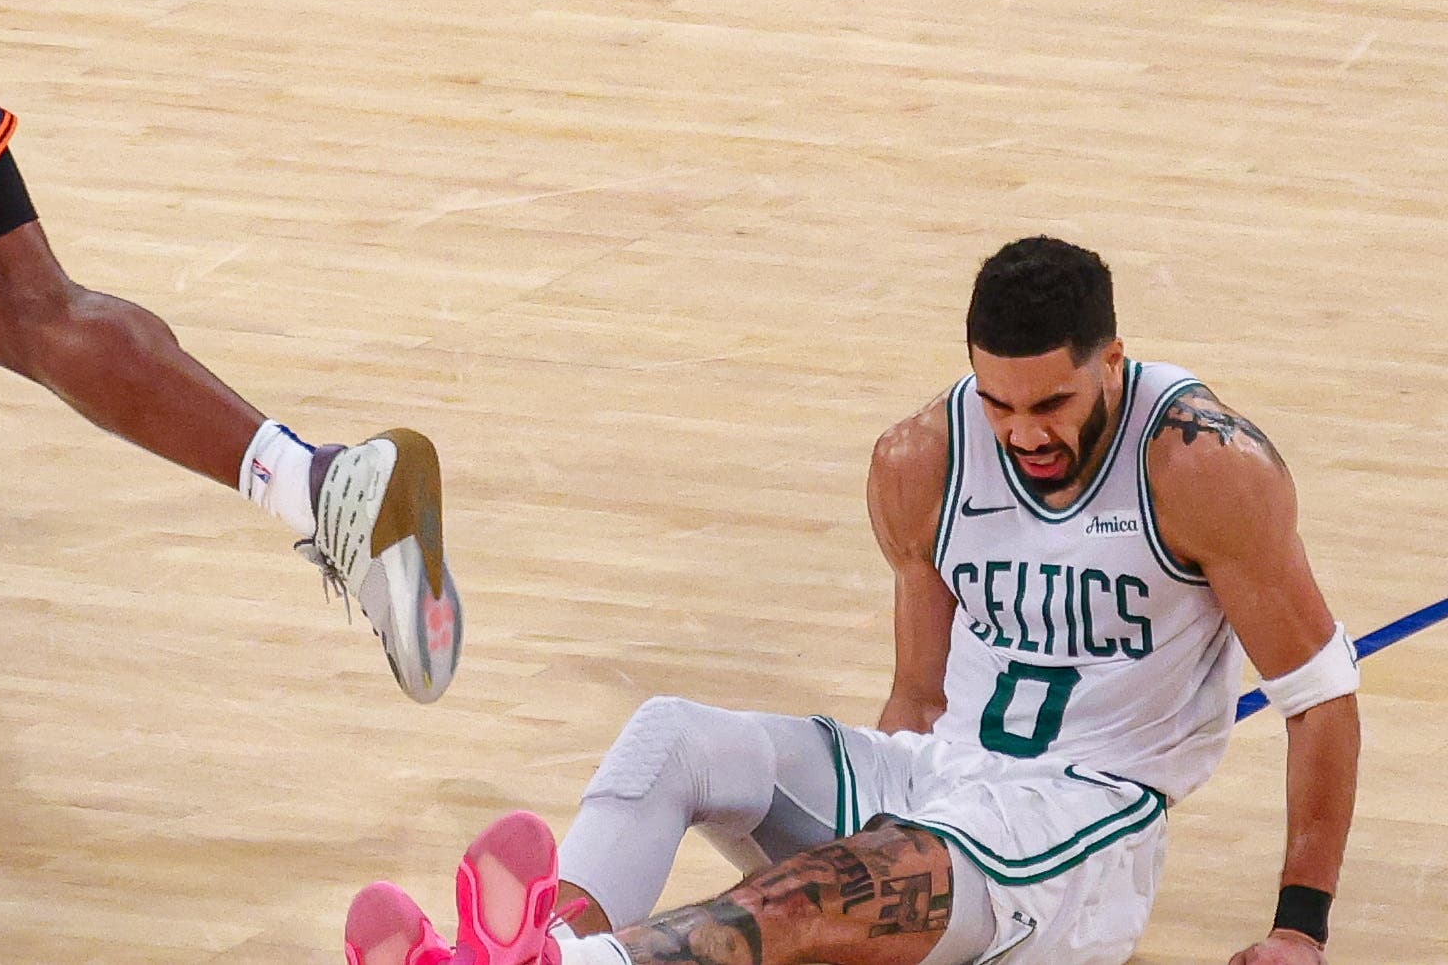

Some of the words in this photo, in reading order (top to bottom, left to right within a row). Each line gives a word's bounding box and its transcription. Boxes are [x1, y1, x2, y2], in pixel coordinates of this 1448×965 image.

[1085, 516, 1139, 534] Amica
[952, 560, 1154, 660] CELTICS
[978, 660, 1083, 759] 0
